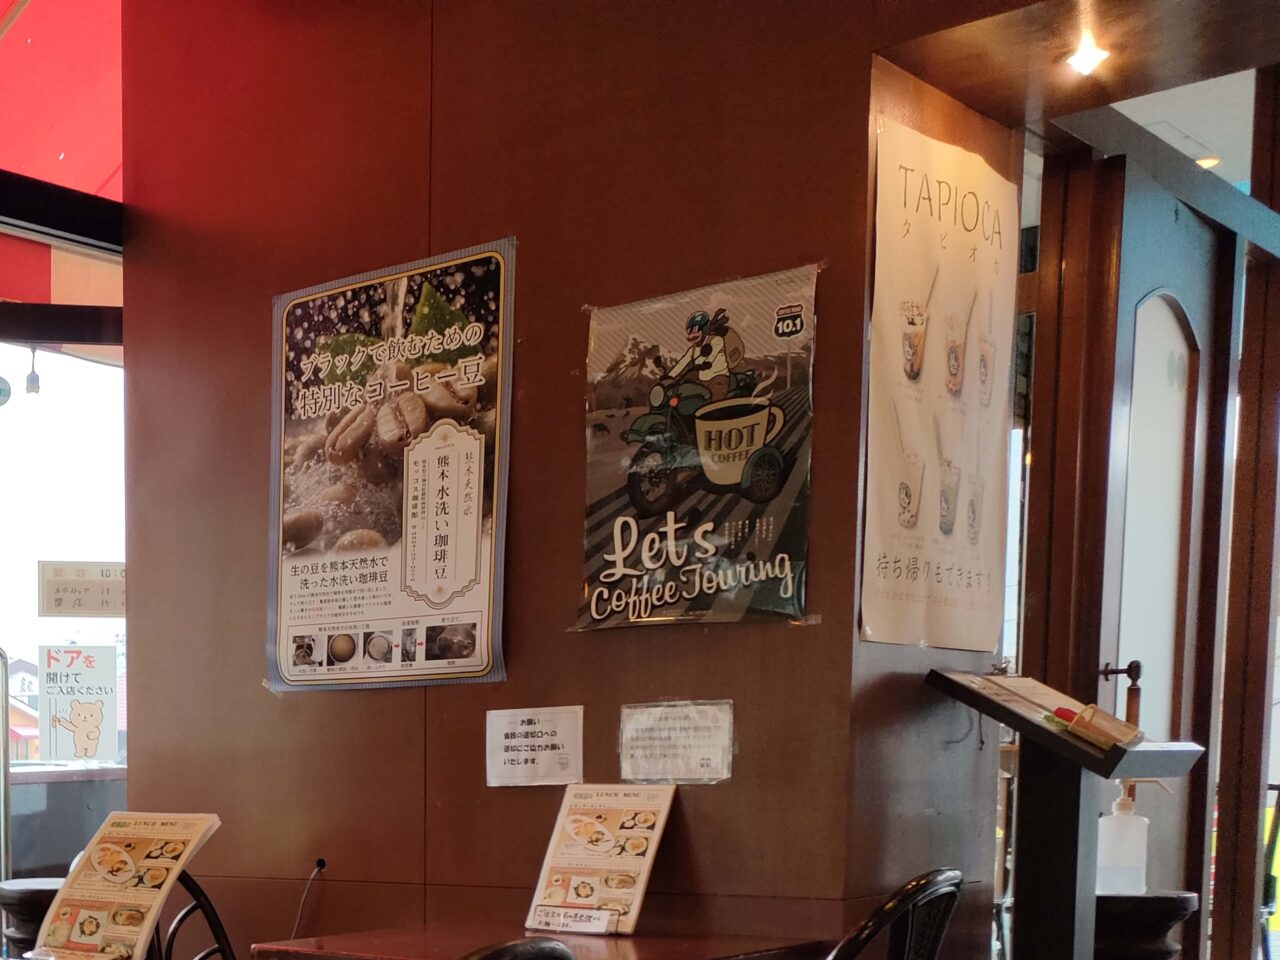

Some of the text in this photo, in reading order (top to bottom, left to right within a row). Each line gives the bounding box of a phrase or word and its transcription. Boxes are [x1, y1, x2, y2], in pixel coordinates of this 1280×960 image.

[898, 164, 1003, 250] TAPIOCA
[775, 317, 803, 335] 10.1
[300, 322, 484, 382] ブラックで飲むための
[297, 353, 486, 420] 特別なコーヒー豆
[702, 423, 761, 452] HOT
[710, 449, 752, 465] COFFEE
[433, 455, 450, 580] 熊本水洗い珈琲豆
[290, 556, 389, 577] 生の豆を熊本天然水で
[300, 570, 389, 590] 洗った水洗い珈琲豆
[590, 552, 795, 621] Coffee Touring
[46, 649, 96, 669] ドアを
[46, 672, 82, 685] 開けて
[46, 685, 114, 696] ご入店ください
[520, 717, 541, 727] お願い
[503, 757, 540, 767] いたします。
